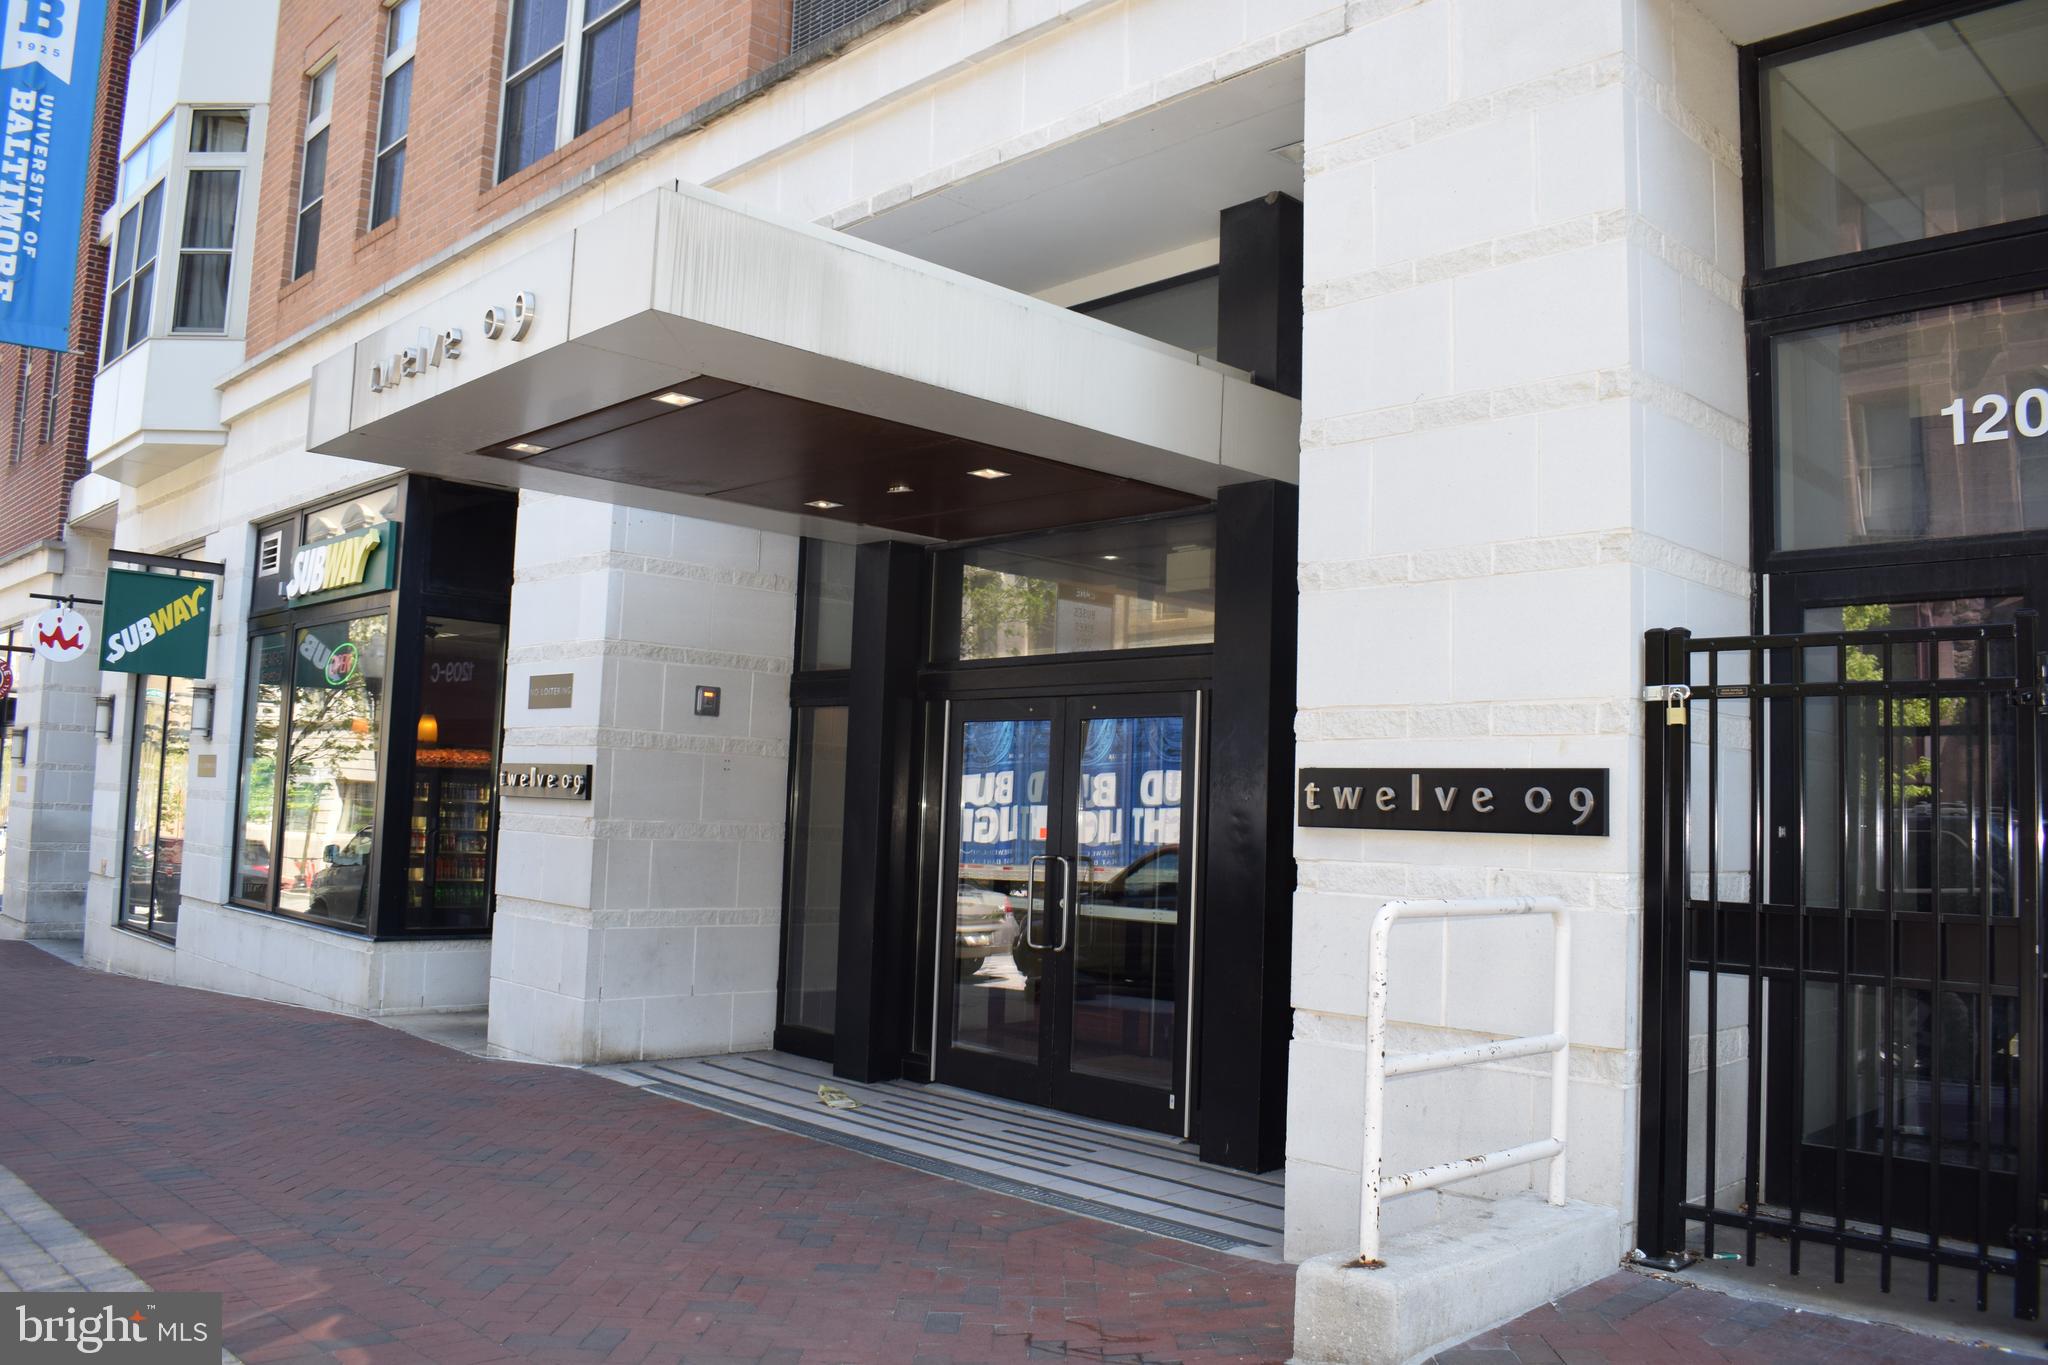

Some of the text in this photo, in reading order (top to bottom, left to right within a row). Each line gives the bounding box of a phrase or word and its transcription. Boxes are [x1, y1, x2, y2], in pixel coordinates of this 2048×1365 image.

[17, 41, 60, 57] 1925
[23, 94, 54, 258] UNIVERSITY OF
[1941, 388, 2048, 446] 120
[286, 528, 380, 600] SUBWAY
[106, 585, 206, 663] SUBWAY
[500, 767, 558, 788] twelve
[1304, 774, 1495, 813] twelve
